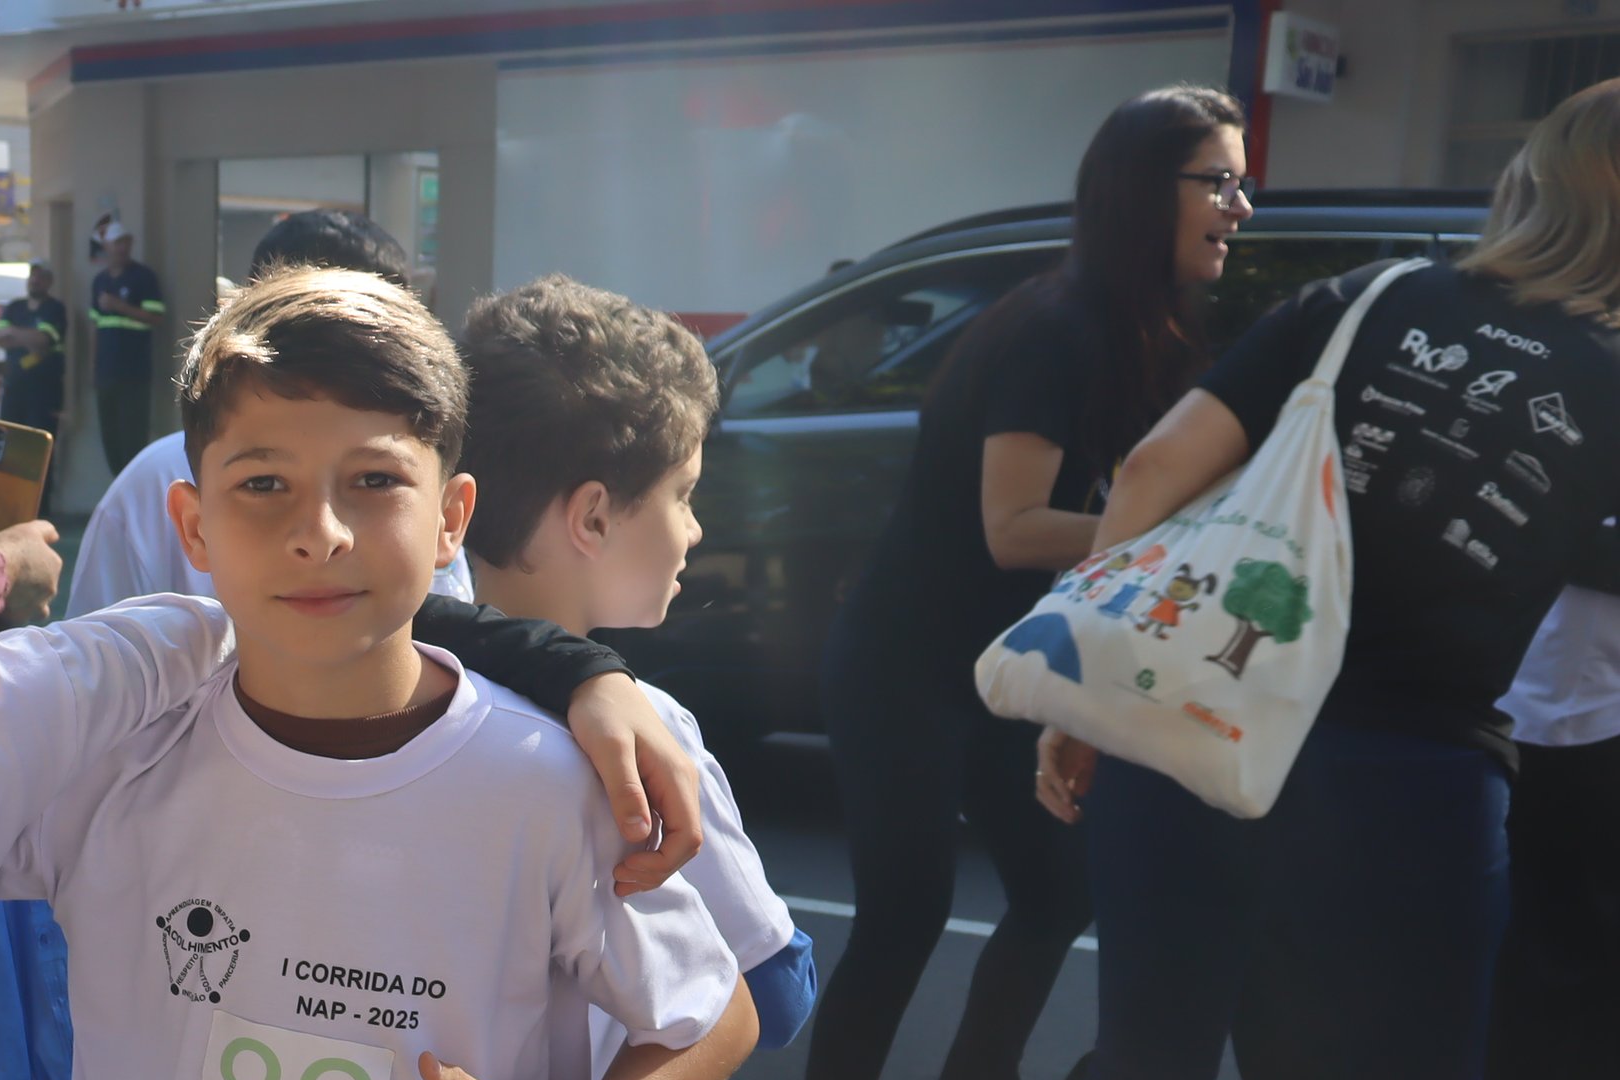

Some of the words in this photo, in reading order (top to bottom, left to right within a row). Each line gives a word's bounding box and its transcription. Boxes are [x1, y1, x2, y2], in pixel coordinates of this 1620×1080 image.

[1476, 323, 1551, 359] APOIO:
[214, 904, 236, 933] EMPATIA
[176, 953, 199, 986] RESPEITO
[218, 949, 239, 989] PARCERIA
[281, 957, 290, 977] I
[294, 960, 405, 996] CORRIDA
[411, 976, 447, 999] DO
[296, 995, 346, 1021] NAP
[367, 1007, 420, 1030] 2025
